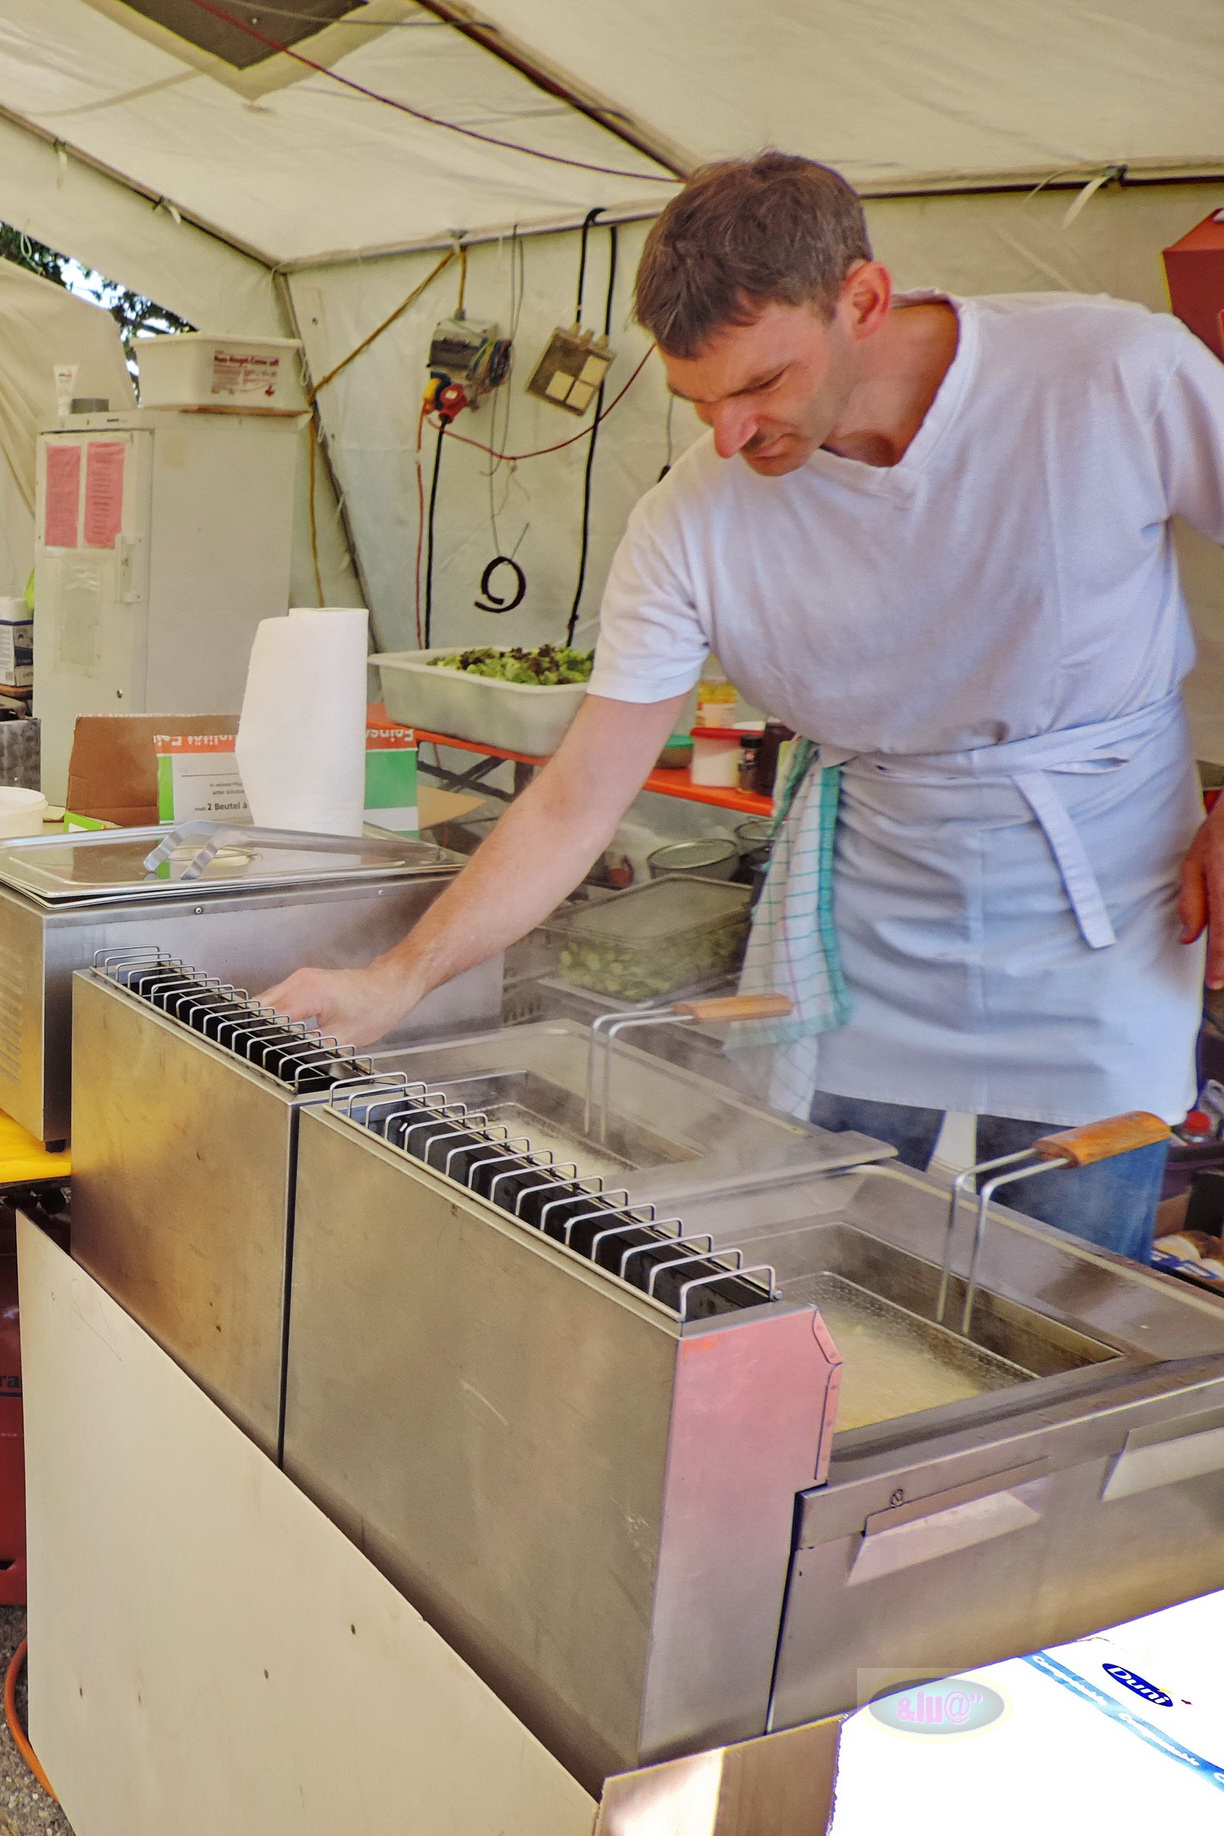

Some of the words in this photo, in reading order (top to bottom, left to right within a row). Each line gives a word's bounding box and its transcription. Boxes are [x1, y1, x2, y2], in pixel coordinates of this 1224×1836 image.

[207, 803, 213, 811] 2
[214, 801, 241, 811] Beutel
[1107, 1666, 1170, 1705] Duni
